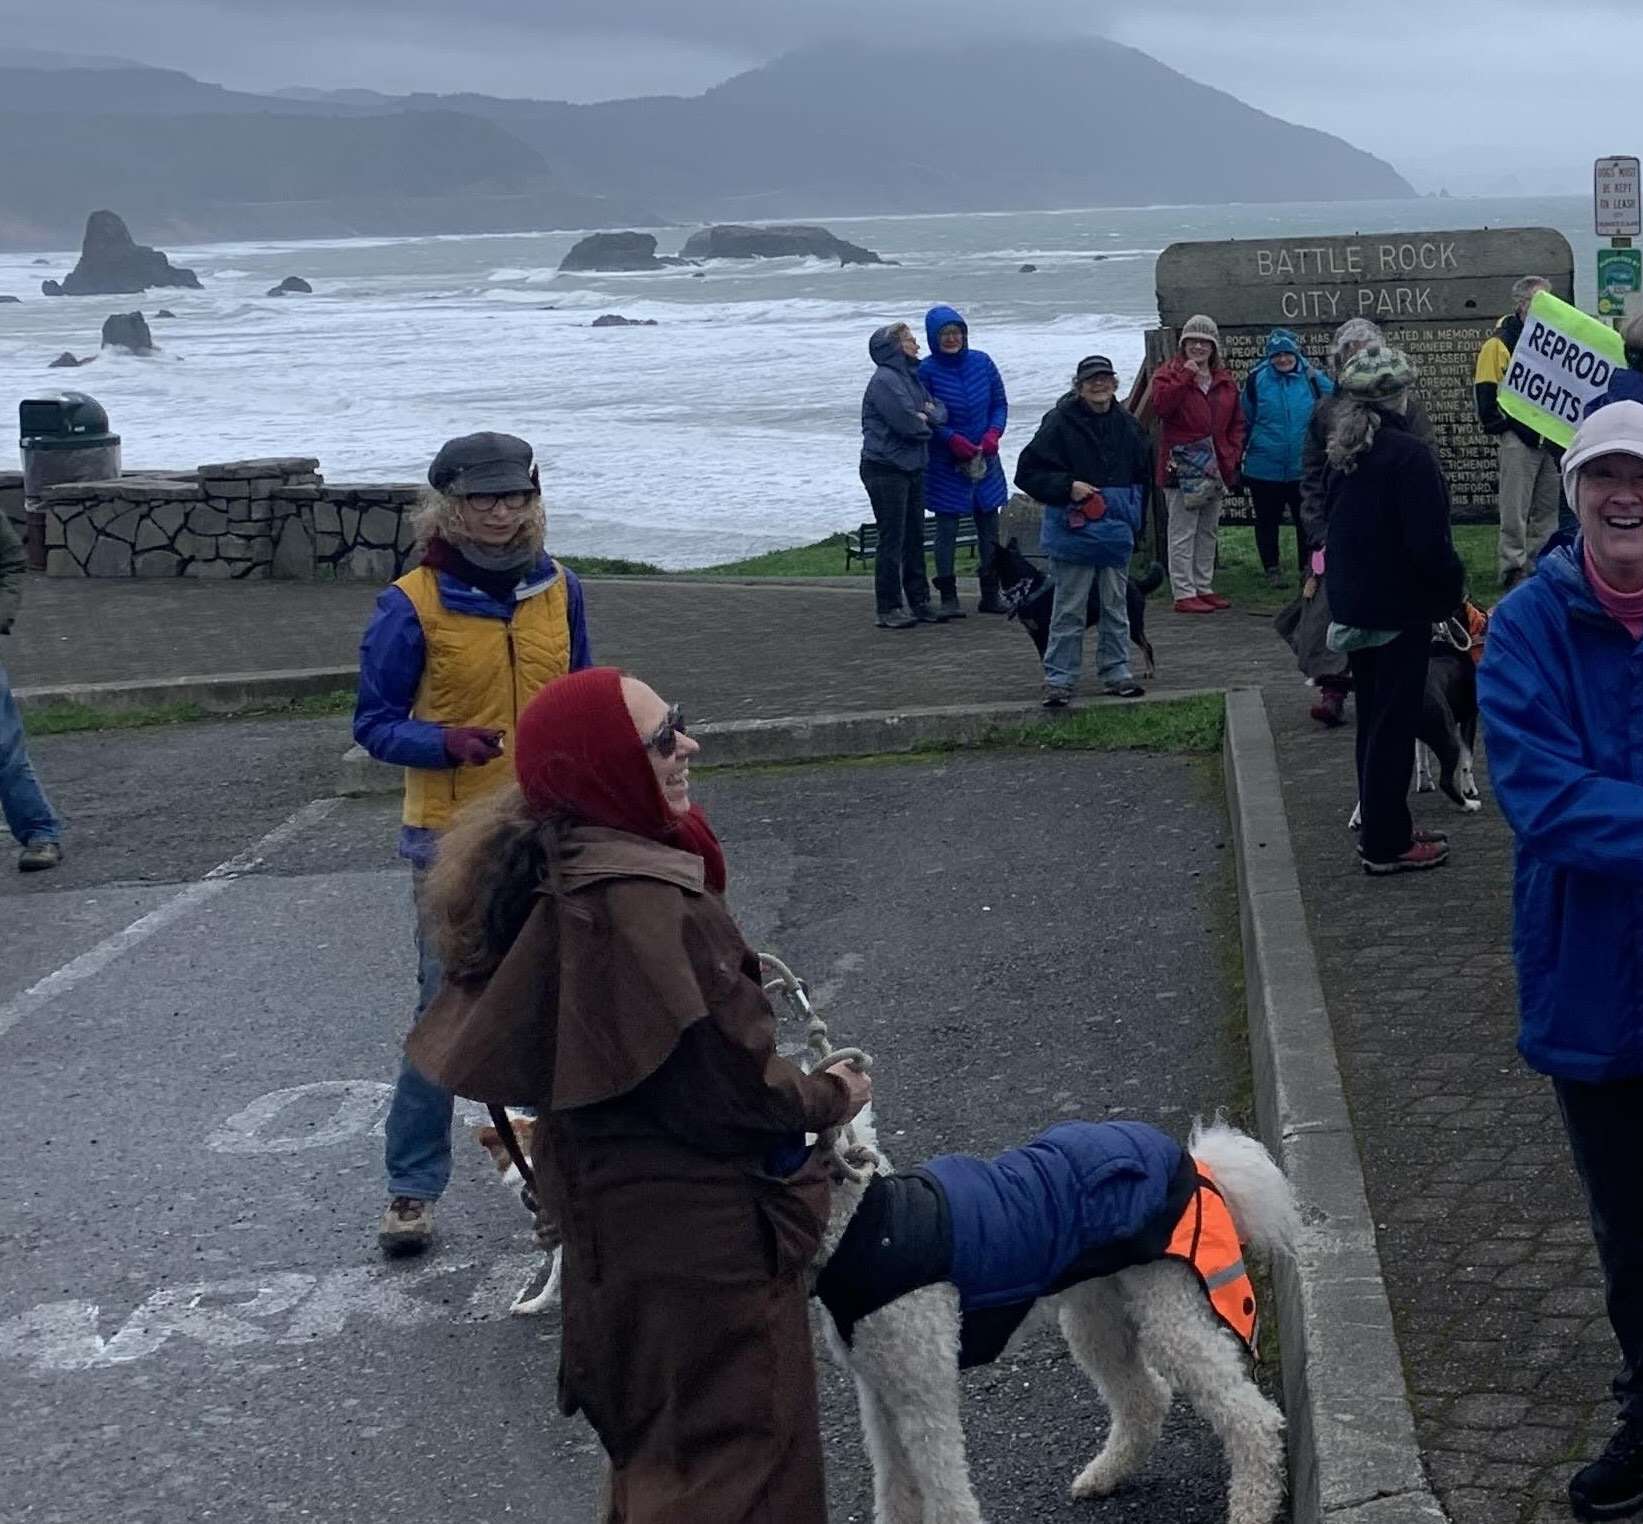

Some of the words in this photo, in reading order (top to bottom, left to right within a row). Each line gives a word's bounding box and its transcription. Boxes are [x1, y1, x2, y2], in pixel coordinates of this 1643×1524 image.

[1257, 247, 1362, 276] BATTLE
[1379, 242, 1458, 271] ROCK
[1281, 291, 1341, 318] CITY
[1358, 287, 1433, 315] PARK
[1226, 336, 1251, 345] ROCK
[1311, 333, 1330, 343] HAS
[1422, 330, 1433, 340] IN
[1438, 328, 1480, 339] MEMORY
[1410, 342, 1453, 353] PIONEER
[1428, 353, 1467, 363] PASSED
[1440, 365, 1472, 375] WHITE
[1420, 377, 1462, 388] OREGON
[1508, 361, 1581, 423] RIGHTS
[1436, 401, 1460, 411] NINE
[1453, 423, 1473, 434] TWO
[1453, 434, 1489, 446] ISLAND
[1460, 448, 1480, 458] THE
